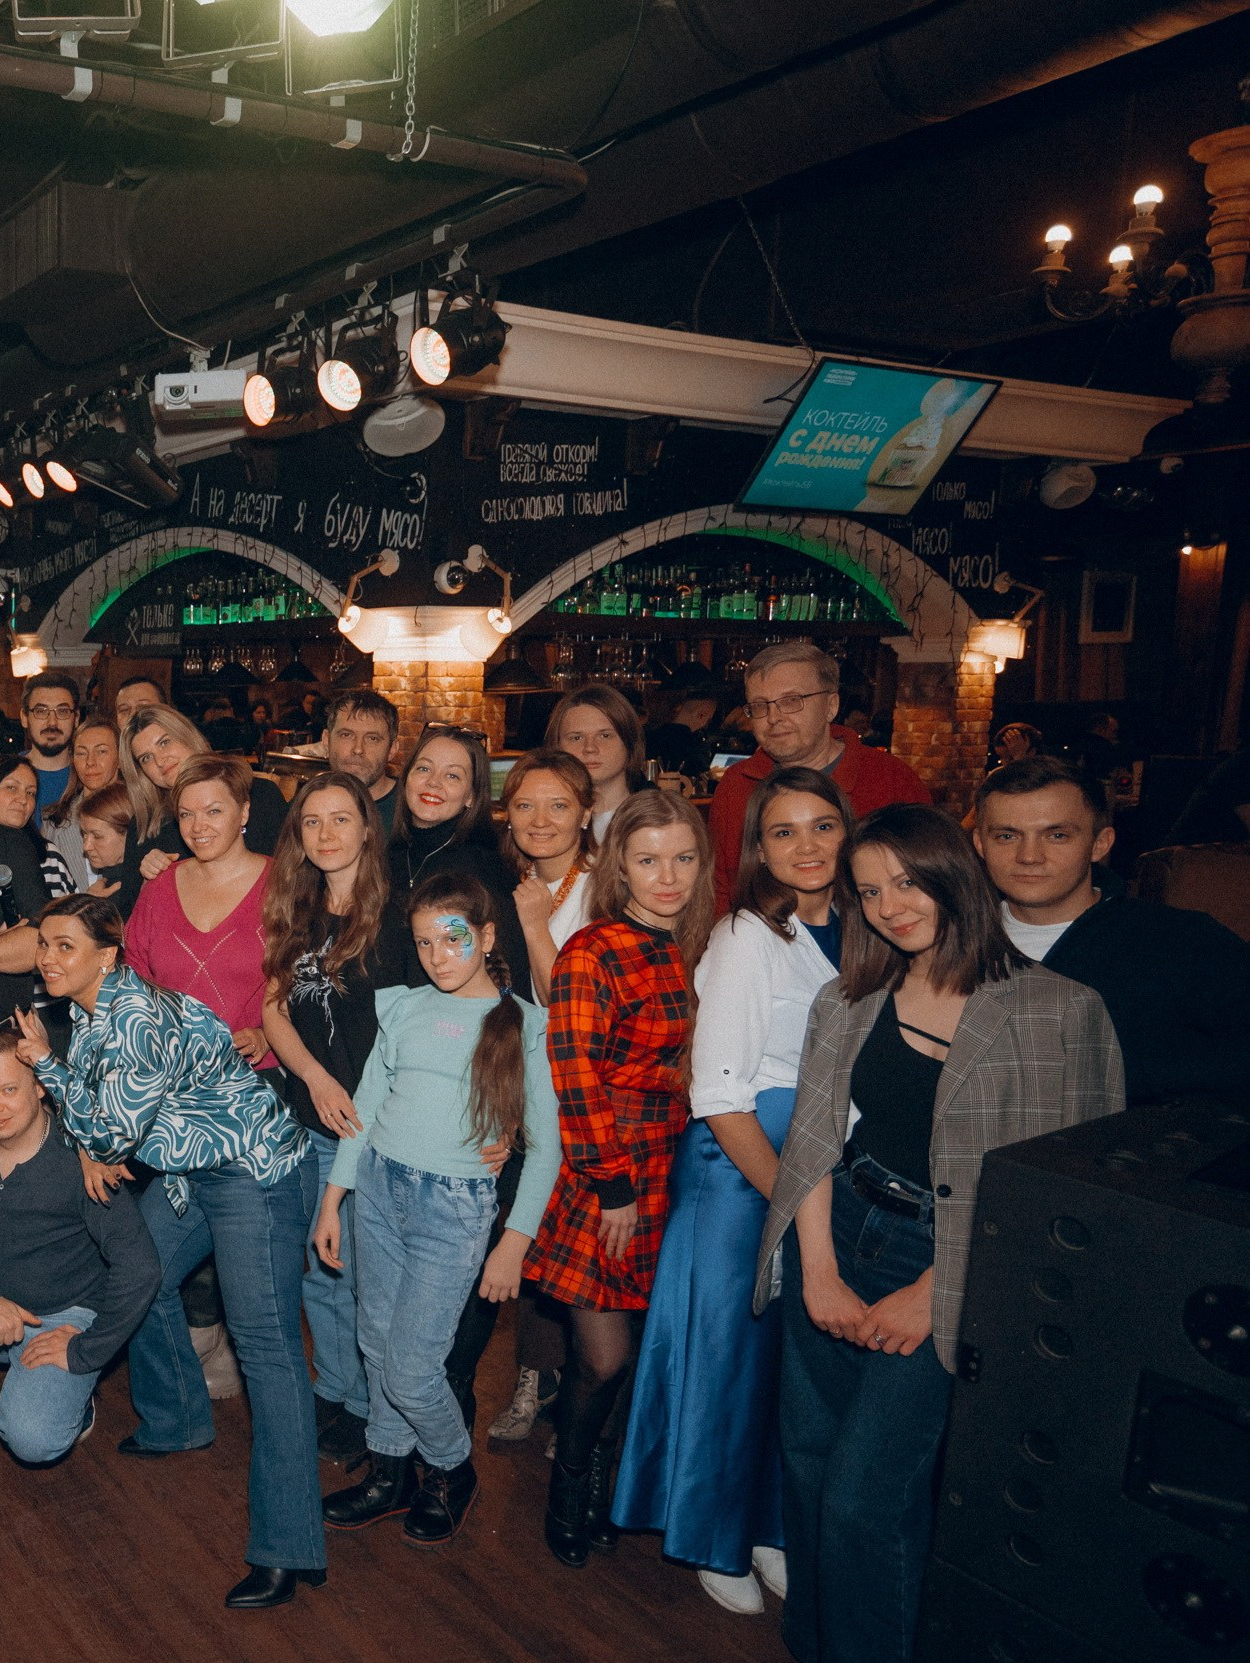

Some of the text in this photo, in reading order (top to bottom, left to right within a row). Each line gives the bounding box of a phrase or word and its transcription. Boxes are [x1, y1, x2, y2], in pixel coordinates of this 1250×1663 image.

[802, 408, 889, 433] КОКТЕЙЛЬ
[805, 431, 880, 455] днем
[190, 472, 200, 517] А
[208, 487, 225, 519] на
[228, 491, 283, 533] десерт
[323, 492, 372, 552] буду
